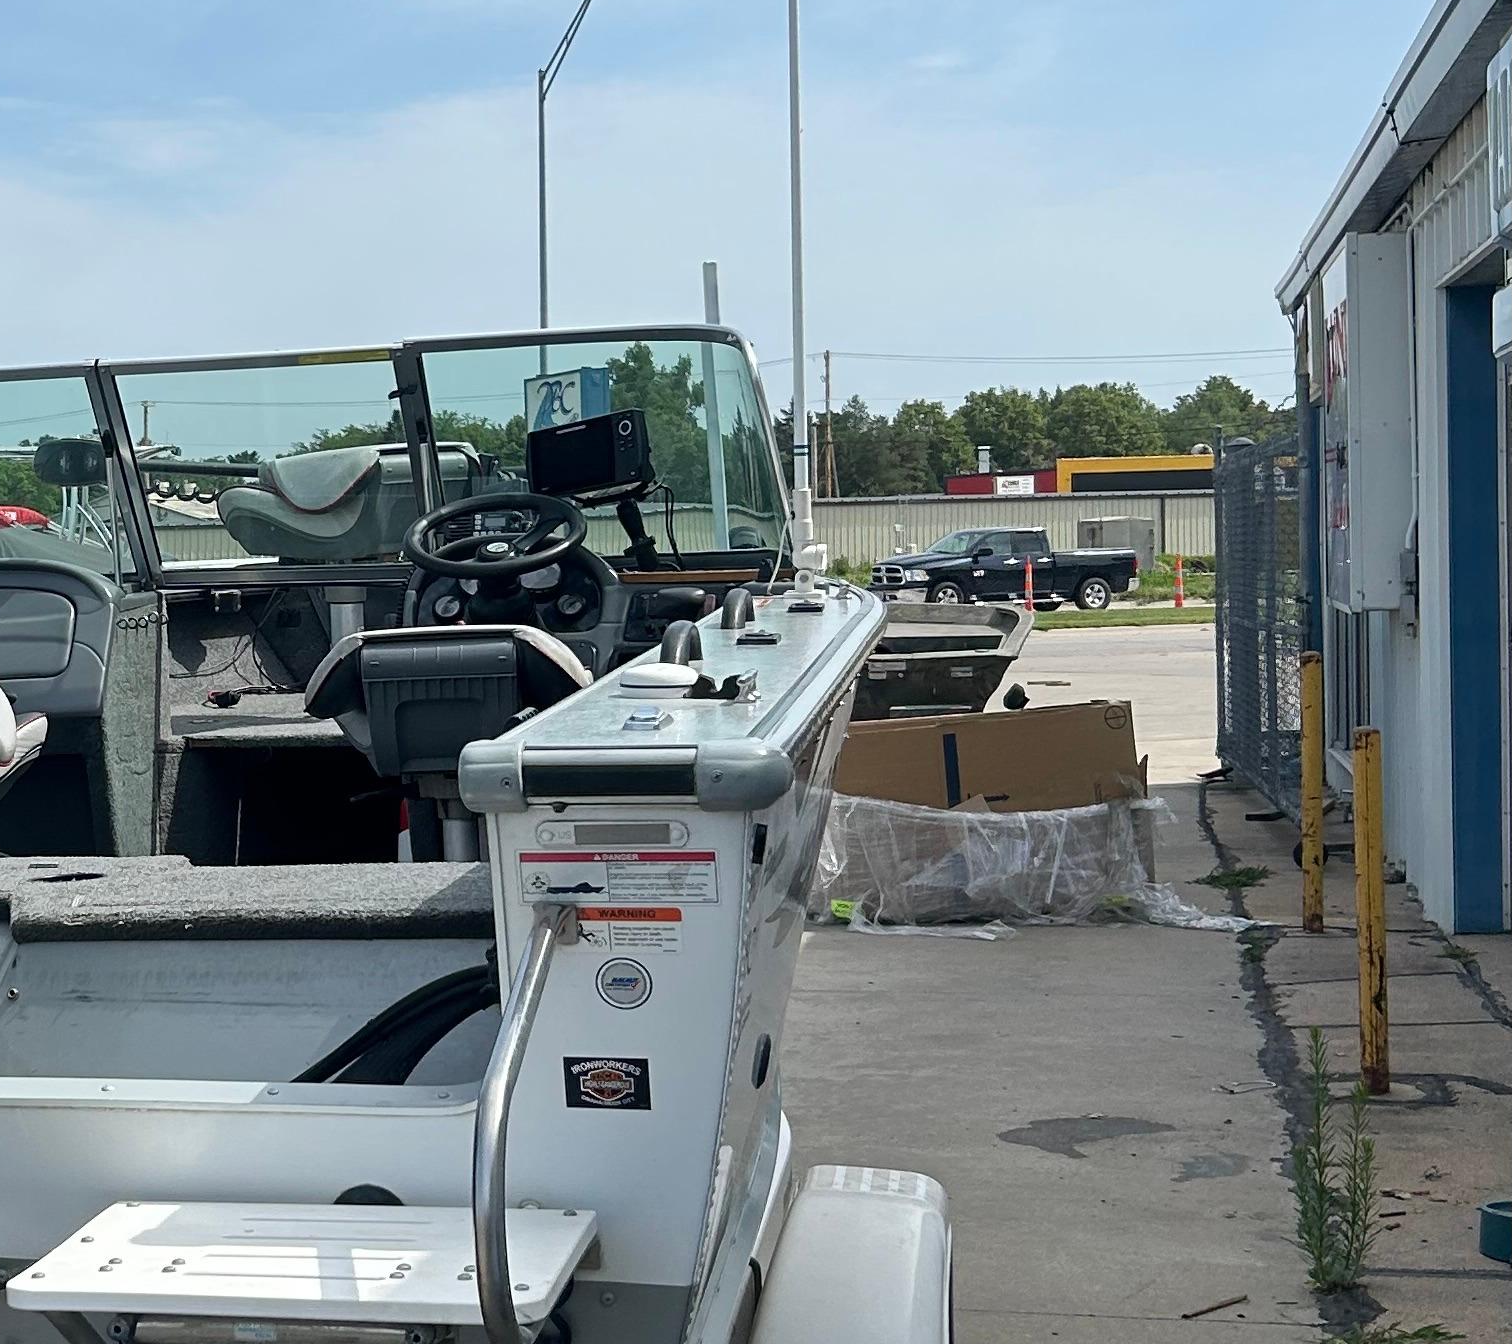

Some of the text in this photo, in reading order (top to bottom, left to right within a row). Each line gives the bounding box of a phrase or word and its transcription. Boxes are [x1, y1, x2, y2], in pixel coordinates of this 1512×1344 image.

[601, 853, 640, 861] DANGER
[598, 909, 657, 918] WARNING
[570, 1059, 642, 1076] IRONWORKERS
